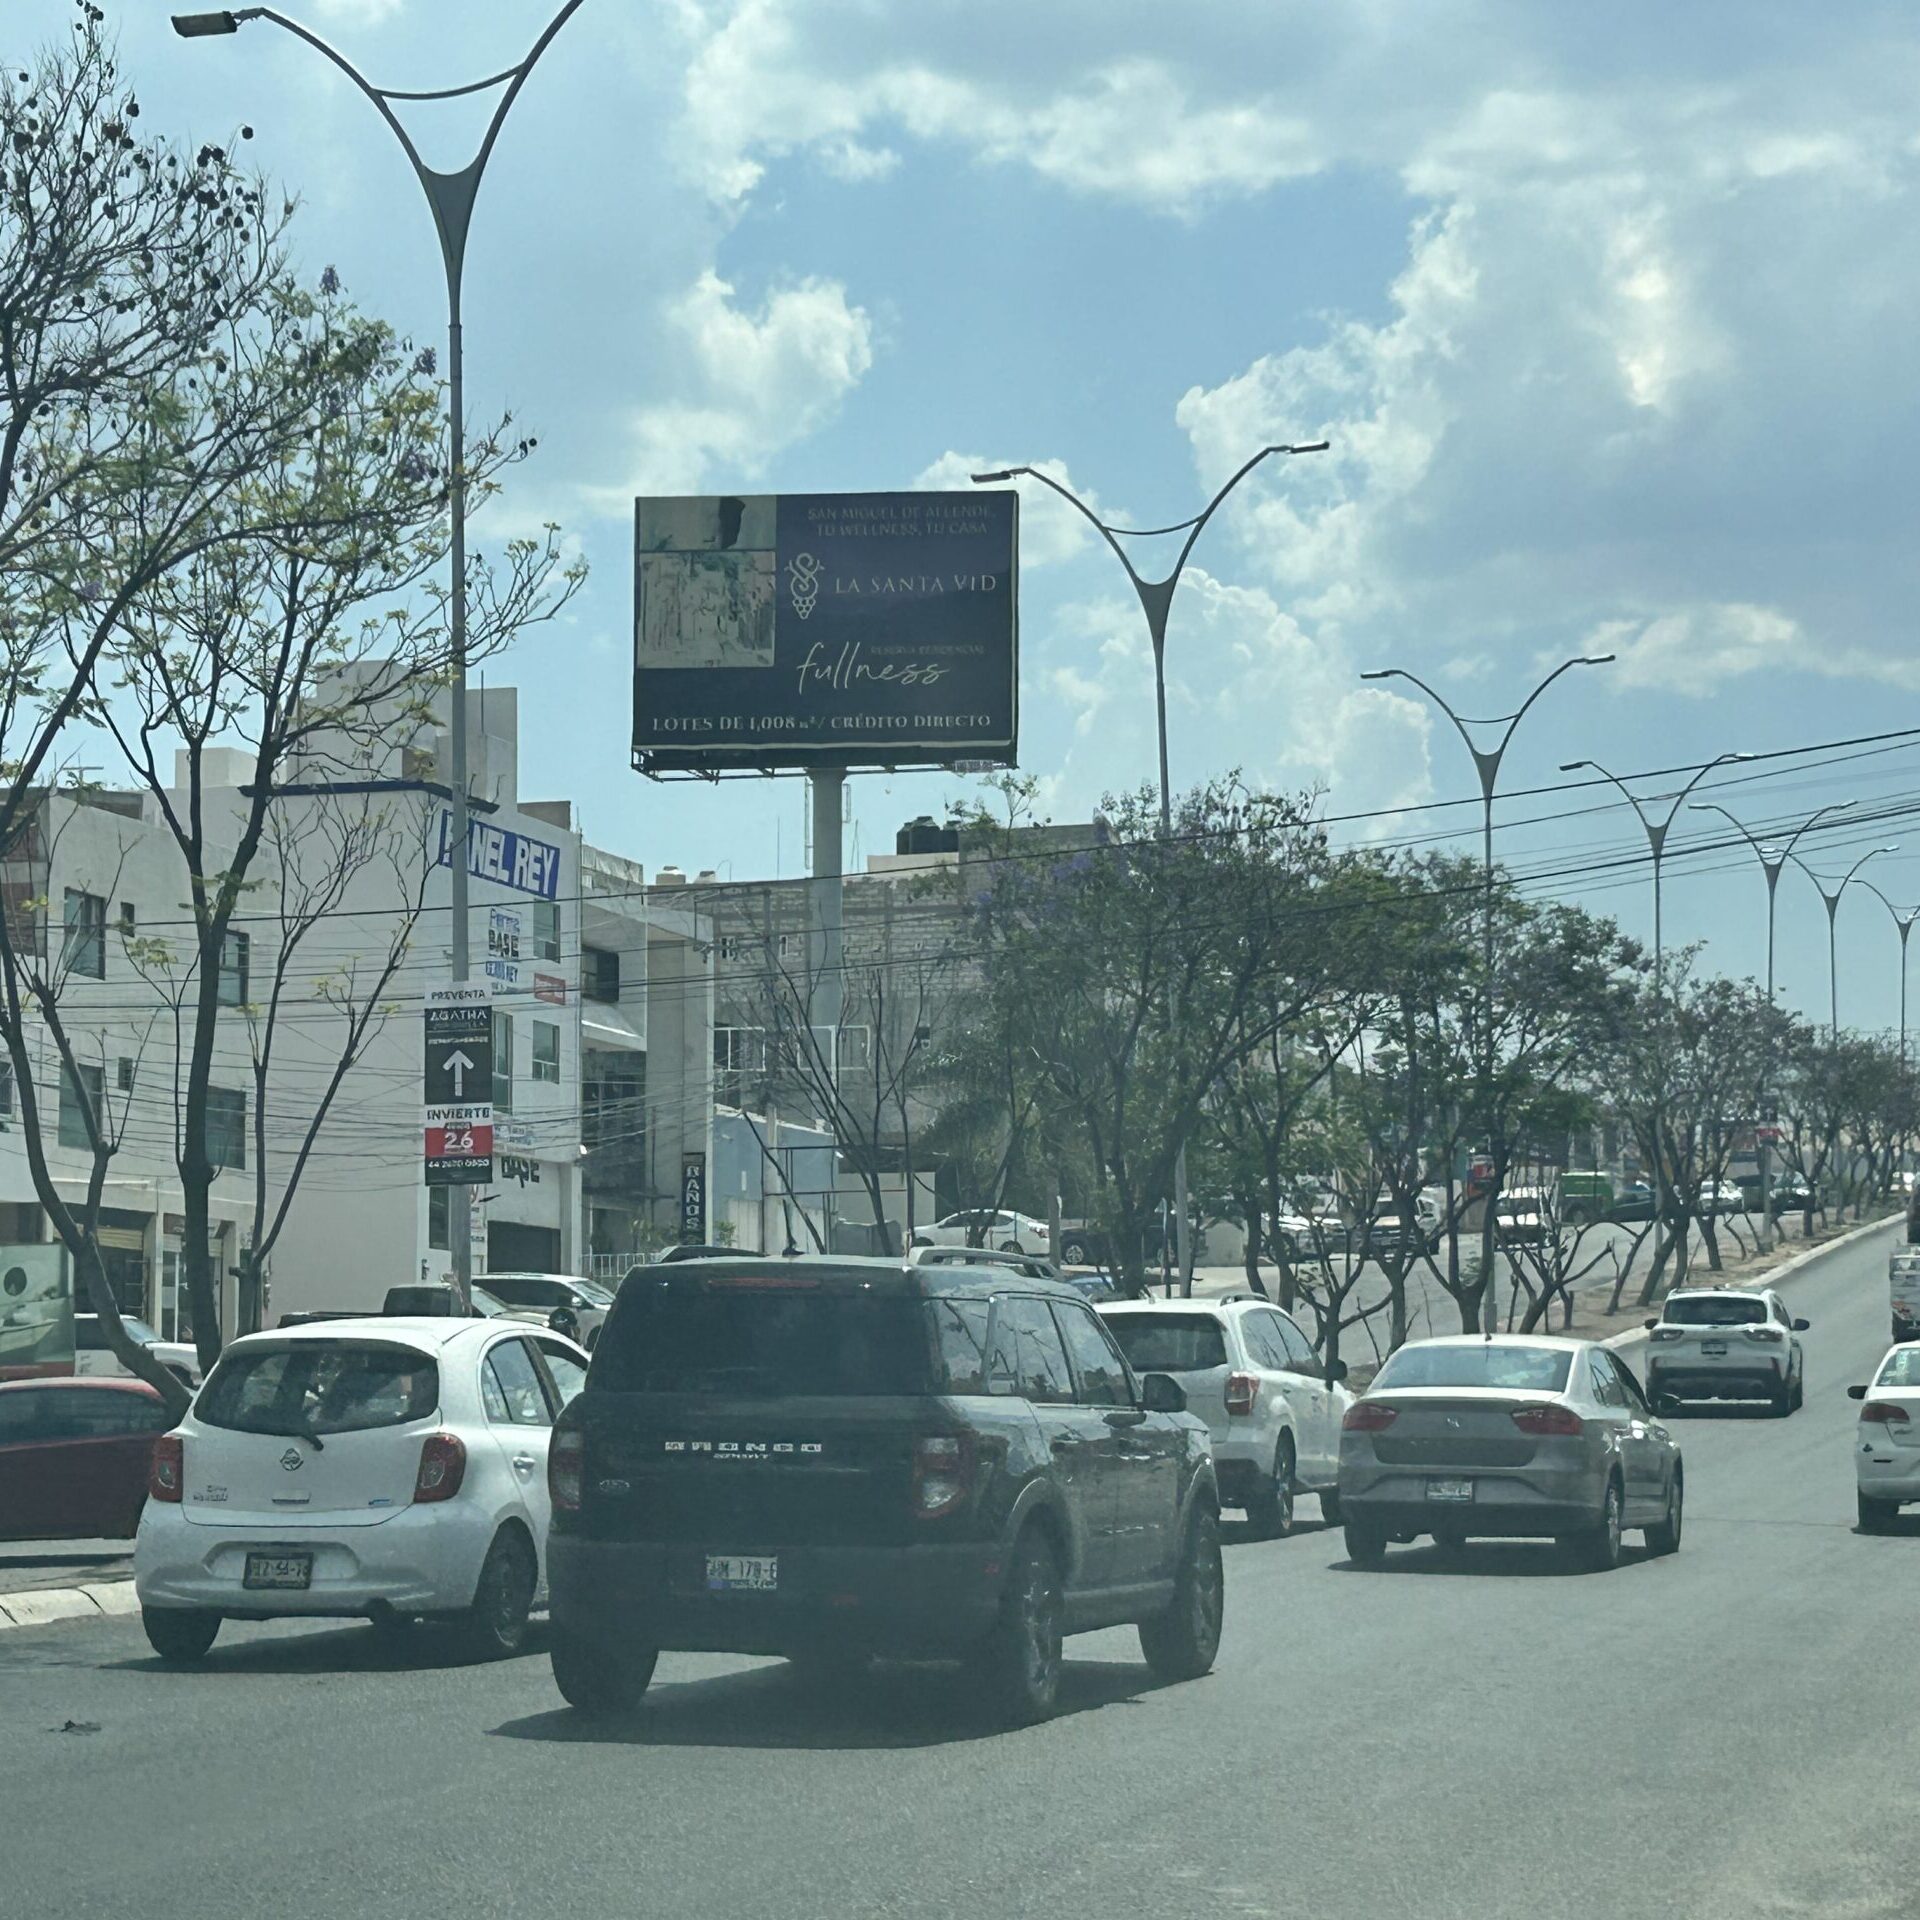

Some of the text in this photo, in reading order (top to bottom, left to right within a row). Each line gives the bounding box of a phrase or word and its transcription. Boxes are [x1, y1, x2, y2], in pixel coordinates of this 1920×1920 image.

[807, 507, 837, 521] SAN
[949, 522, 988, 535] CASA
[835, 574, 997, 594] LA SANTA VID
[796, 641, 951, 695] fullness
[652, 717, 714, 732] LOTES
[719, 717, 744, 731] DE
[749, 716, 796, 733] 1,008
[831, 712, 909, 730] CRÉDITO
[914, 714, 992, 729] DIRECTO
[514, 837, 555, 895] REY
[431, 989, 486, 1001] PREVENTA
[444, 1129, 474, 1149] 26
